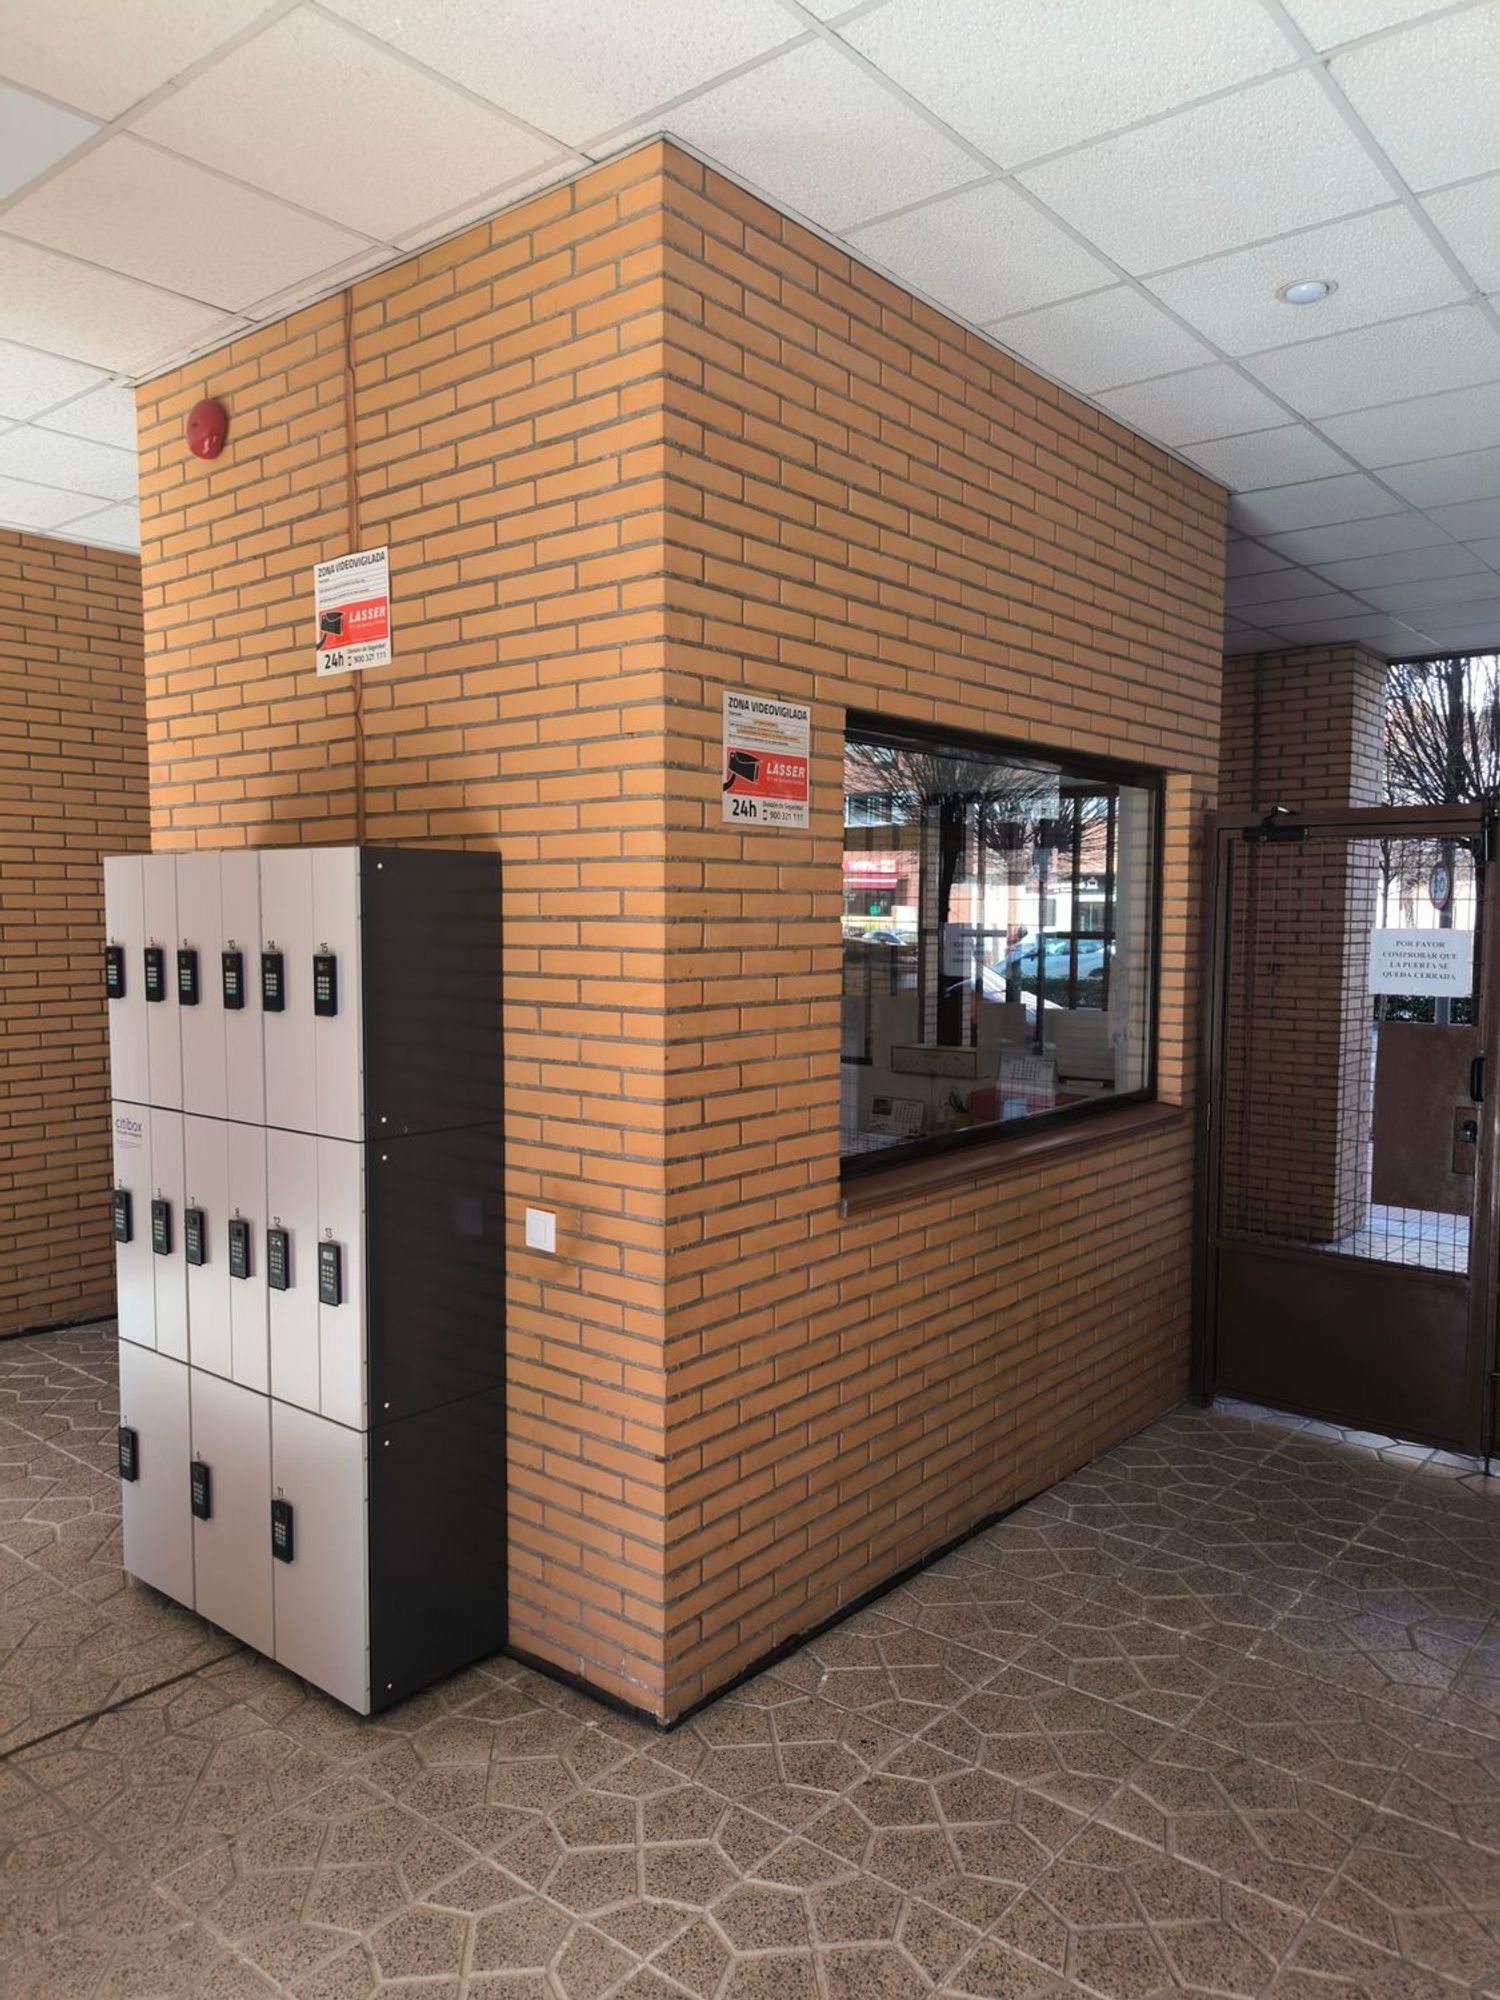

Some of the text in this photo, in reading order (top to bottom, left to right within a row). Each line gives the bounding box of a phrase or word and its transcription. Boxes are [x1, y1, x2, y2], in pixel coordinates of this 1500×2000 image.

[318, 551, 385, 577] ZONA VIDEOVIGILADA
[349, 605, 386, 624] LASSER
[324, 651, 344, 669] 24h
[728, 697, 808, 720] ZONA VIDEOVIGILADA
[766, 762, 806, 778] LASSER
[732, 798, 757, 817] 24h
[770, 811, 780, 819] 900
[1415, 940, 1446, 948] FAVOR
[1382, 951, 1457, 960] COMPROBAR QUE
[1414, 972, 1456, 980] CERRADA
